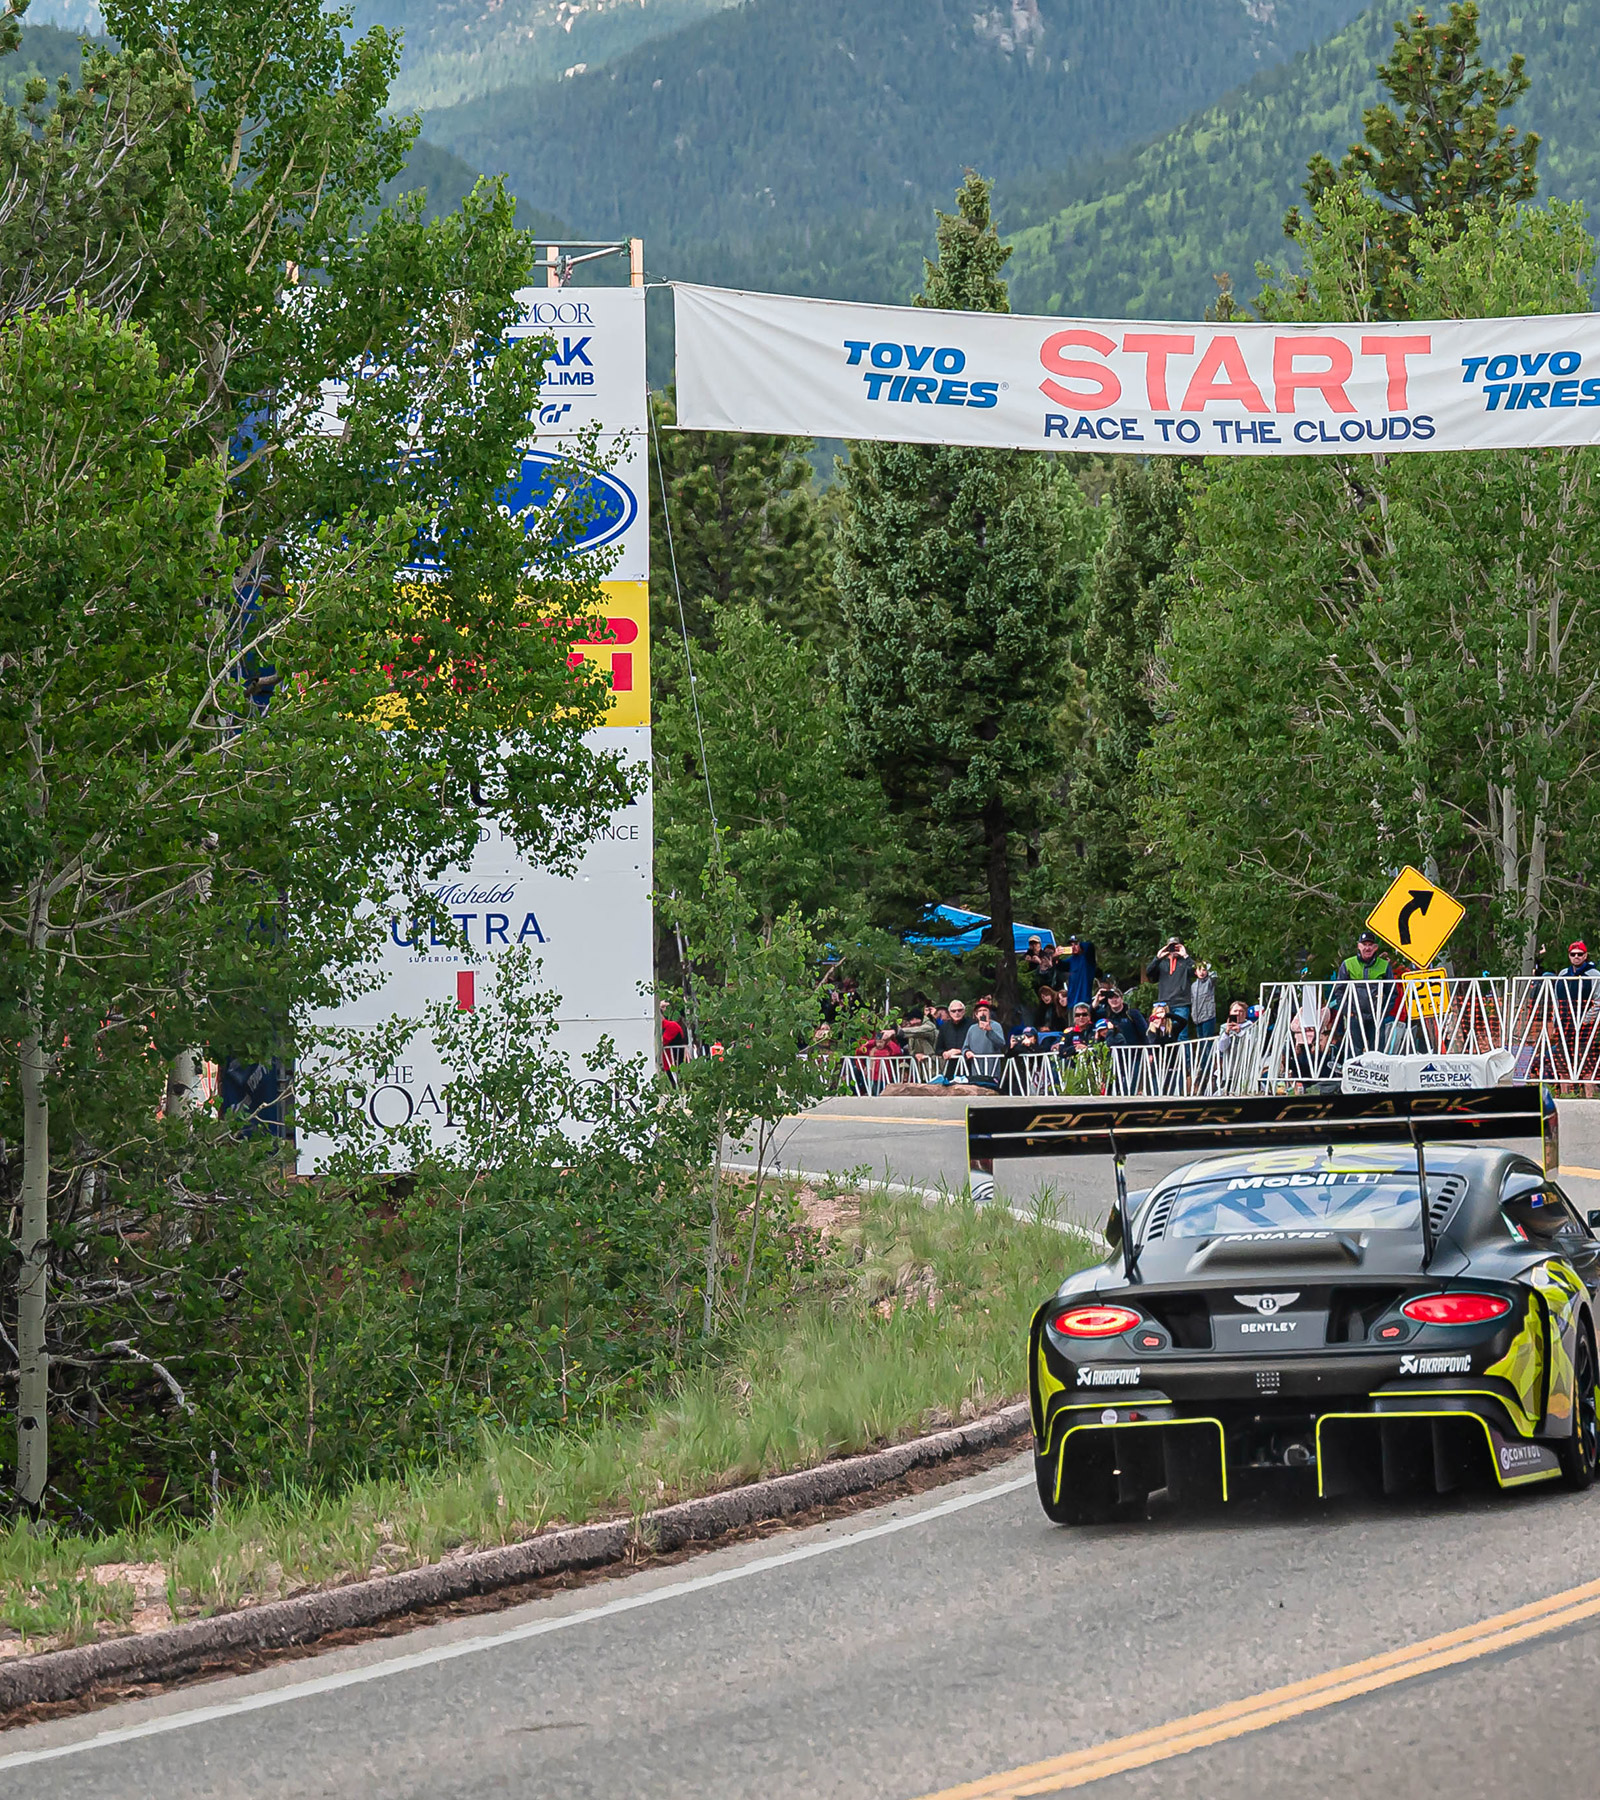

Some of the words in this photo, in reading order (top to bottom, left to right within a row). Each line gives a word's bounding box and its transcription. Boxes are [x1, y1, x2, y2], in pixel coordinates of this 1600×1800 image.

[843, 341, 966, 376] TOYO
[1038, 329, 1432, 411] START
[1461, 351, 1582, 383] TOYO
[863, 372, 1000, 409] TIRES
[1044, 413, 1144, 442] RACE
[1153, 417, 1201, 444] TO
[1213, 419, 1282, 444] THE
[1294, 415, 1436, 443] CLOUDS
[422, 882, 518, 905] Michelob
[391, 912, 546, 948] ULTRA
[1410, 975, 1442, 1000] 25
[367, 1065, 414, 1084] THE
[1347, 1067, 1369, 1080] PIKES
[1369, 1071, 1390, 1083] PEAK
[1420, 1074, 1446, 1083] PIKES
[1449, 1073, 1472, 1082] PEAK
[1227, 1172, 1338, 1191] Mobil
[1224, 1231, 1330, 1243] FANATEC
[1241, 1322, 1297, 1333] BENTLEY
